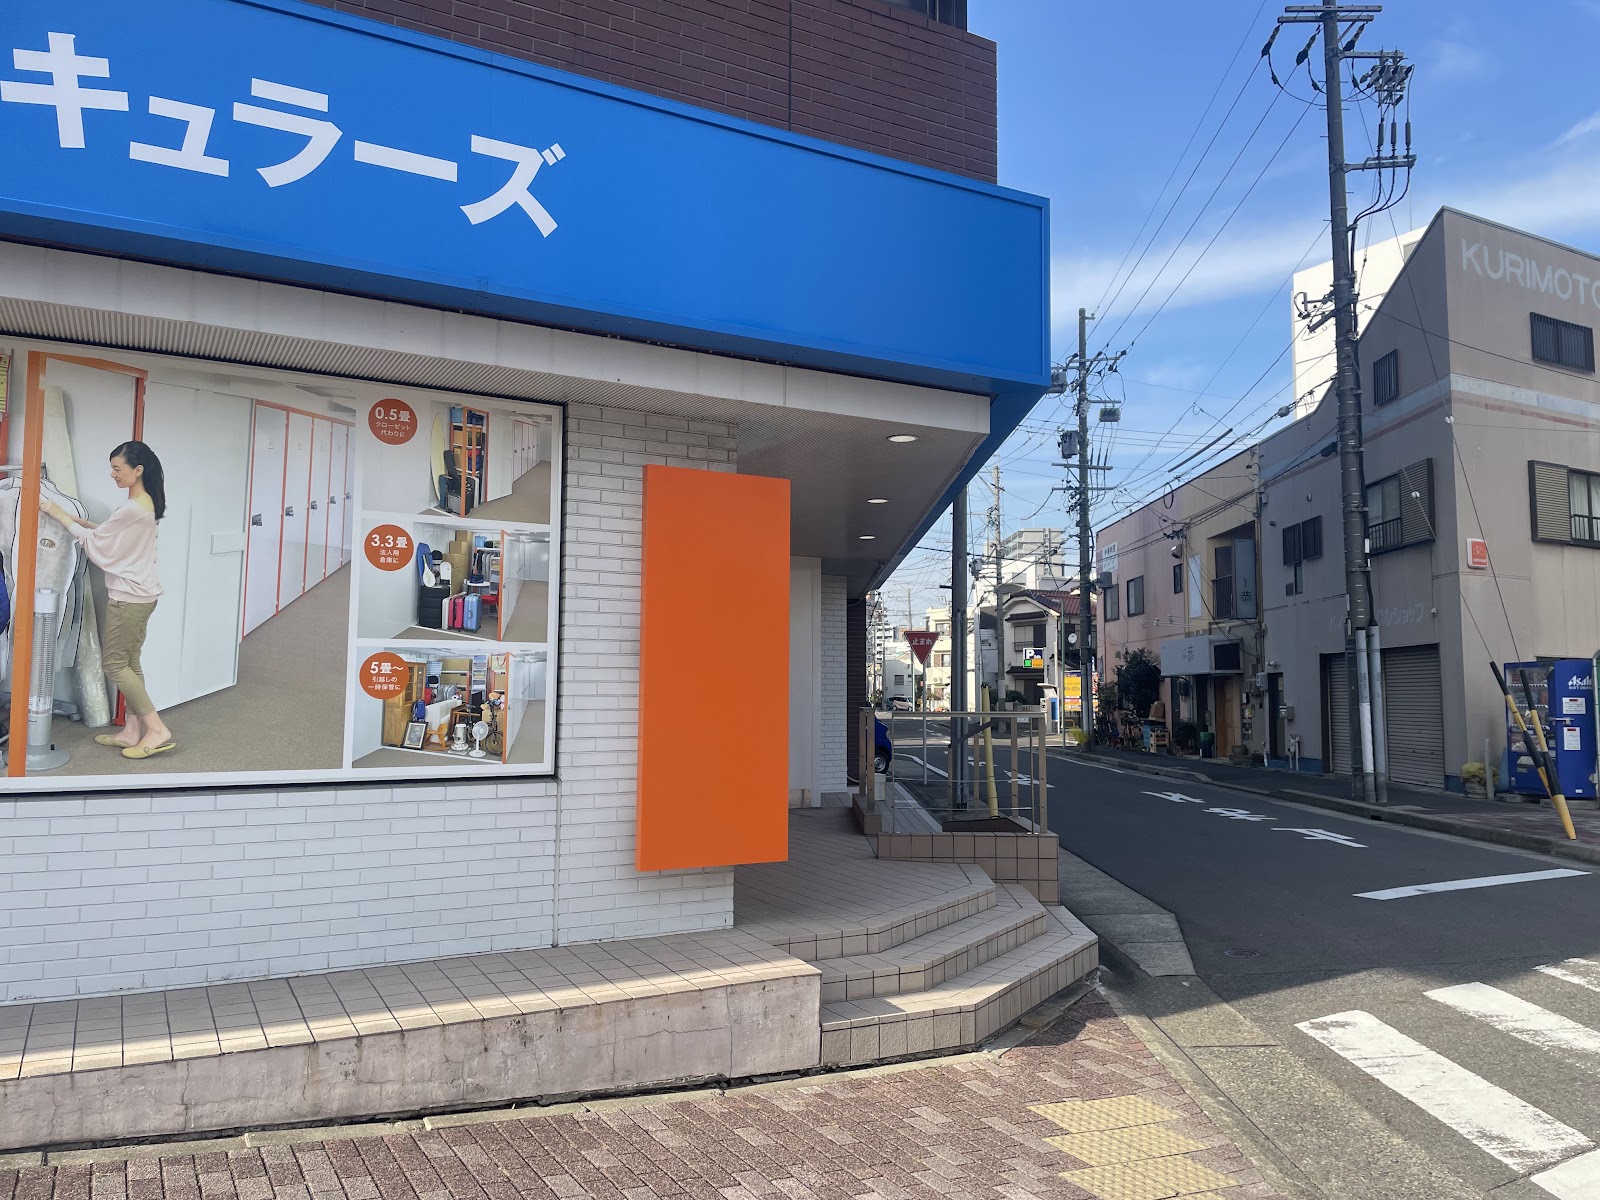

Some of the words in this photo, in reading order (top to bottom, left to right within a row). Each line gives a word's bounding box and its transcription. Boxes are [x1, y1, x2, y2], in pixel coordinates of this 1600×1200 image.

[0, 31, 567, 239] キュラーズ
[375, 406, 411, 423] 0.5畳
[375, 421, 412, 431] クローゼット
[380, 429, 406, 438] 代わりに
[371, 533, 408, 549] 3.3畳
[379, 549, 400, 557] 法人用
[912, 637, 933, 646] 止まれ
